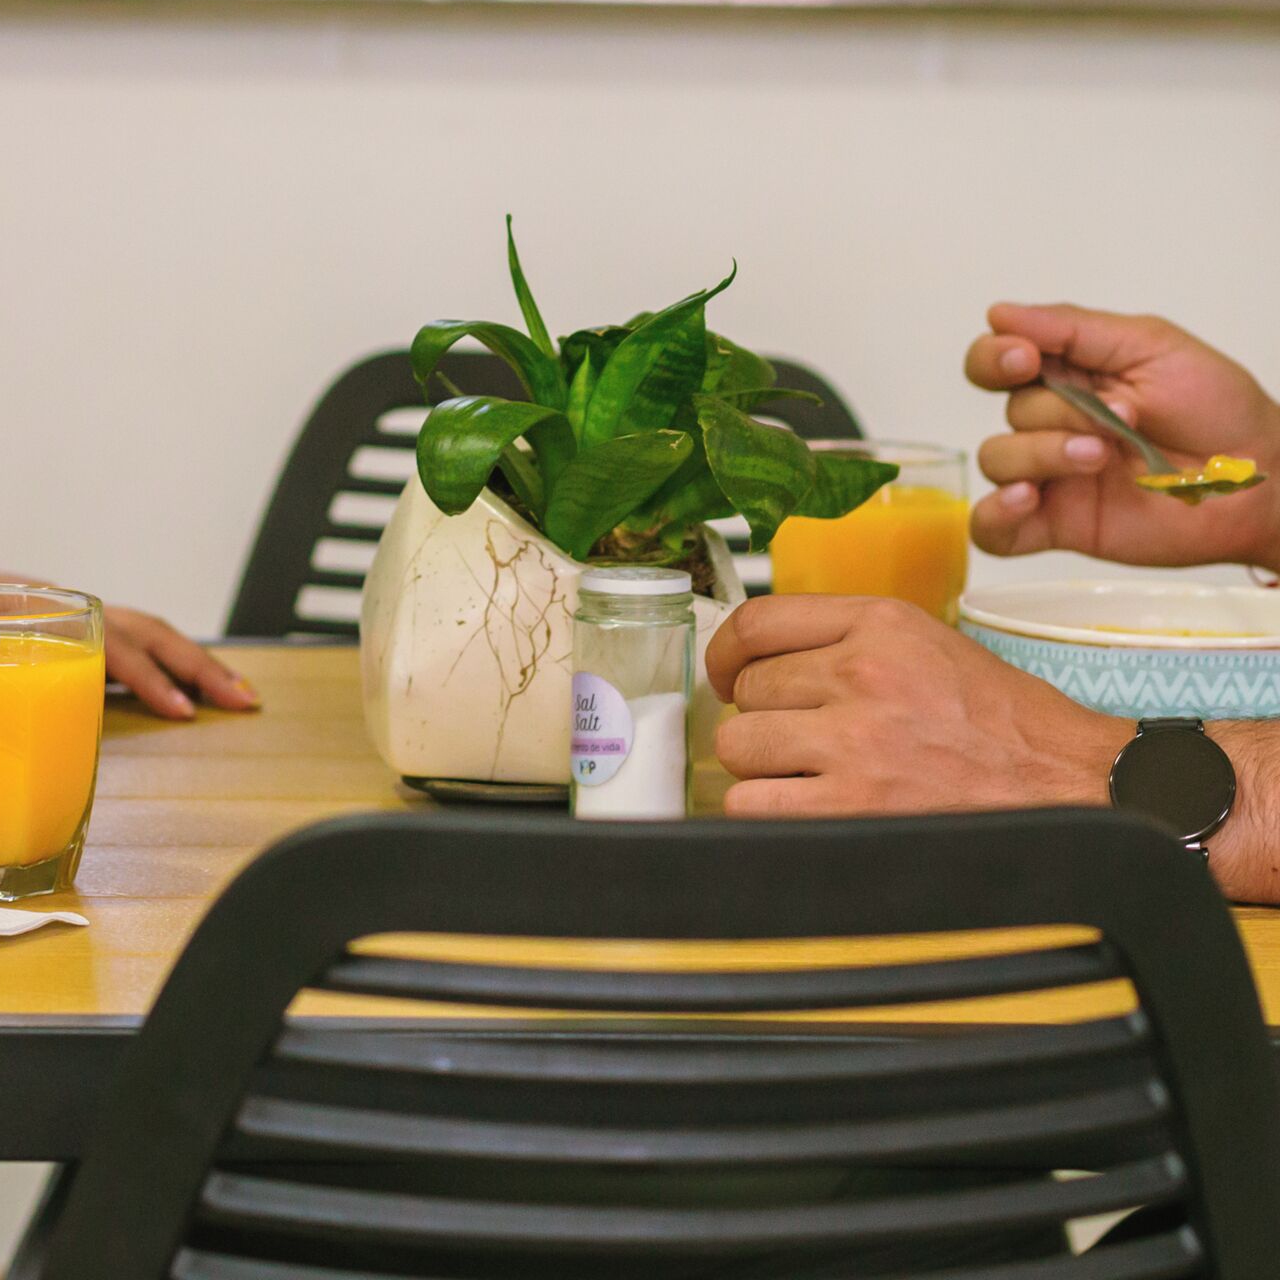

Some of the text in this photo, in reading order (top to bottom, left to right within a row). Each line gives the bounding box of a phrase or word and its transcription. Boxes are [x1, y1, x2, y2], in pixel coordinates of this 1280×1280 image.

[576, 693, 597, 711] Sal
[575, 713, 601, 731] Salt
[591, 743, 600, 752] de
[601, 742, 620, 751] vida
